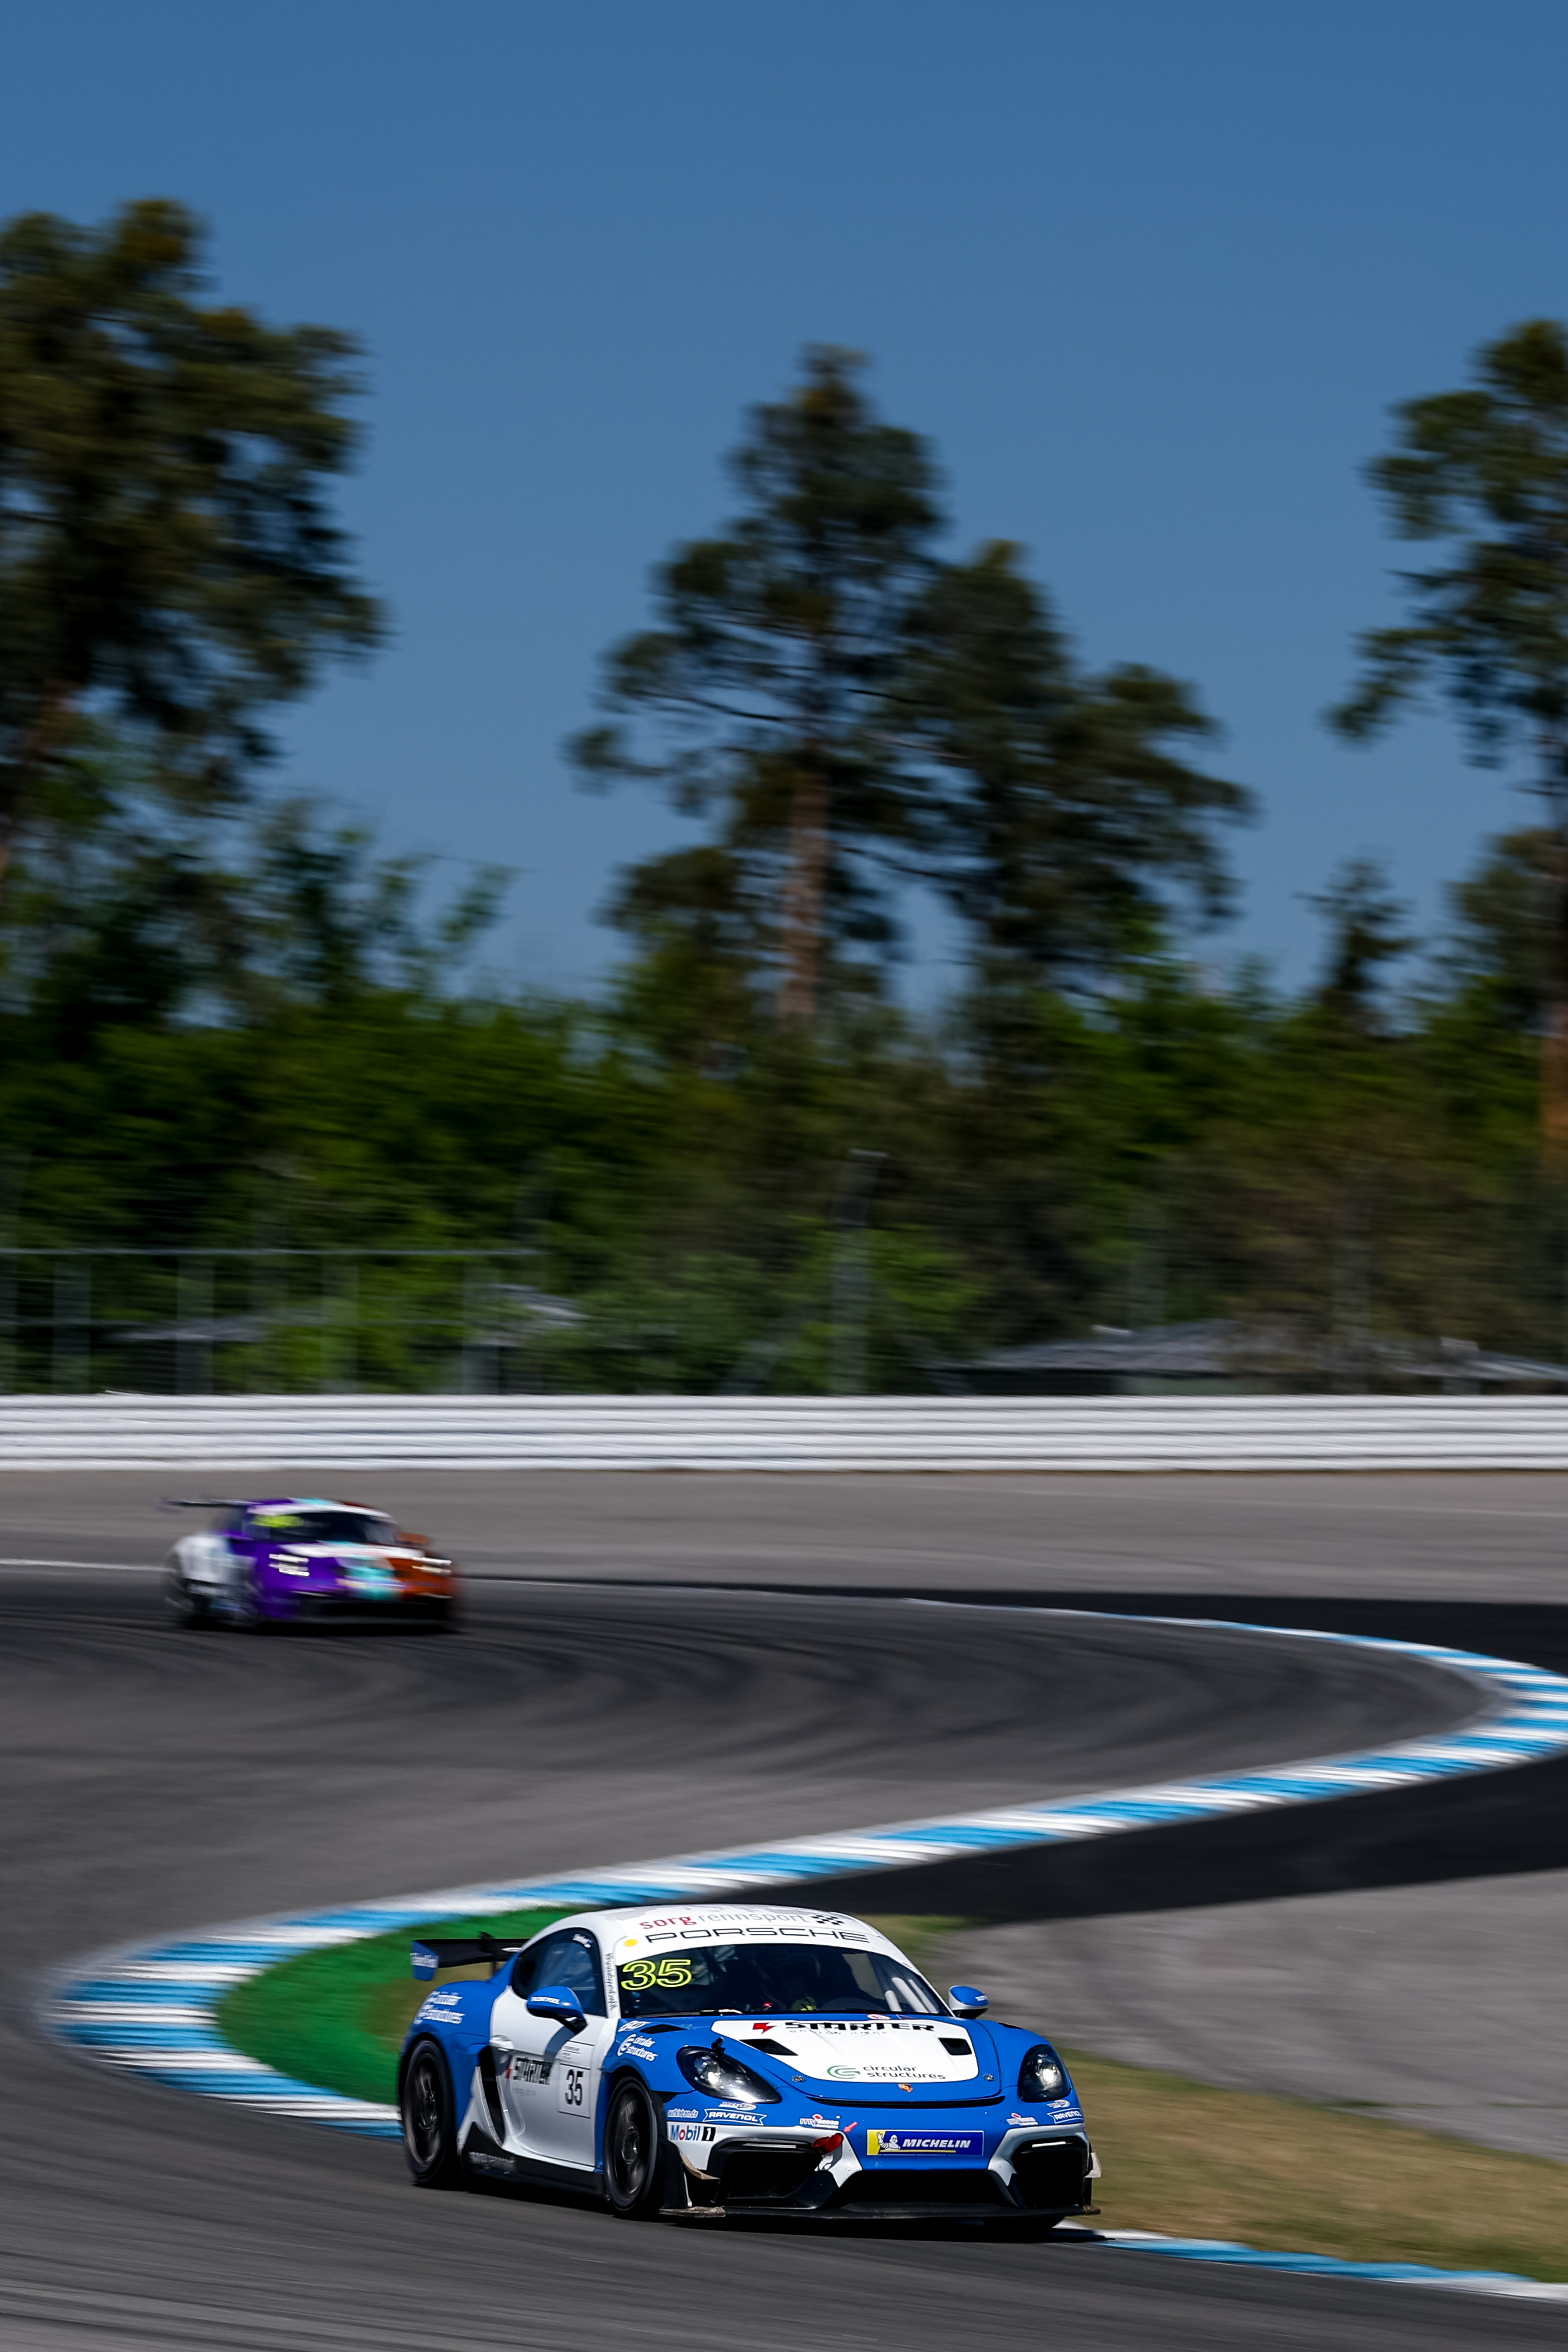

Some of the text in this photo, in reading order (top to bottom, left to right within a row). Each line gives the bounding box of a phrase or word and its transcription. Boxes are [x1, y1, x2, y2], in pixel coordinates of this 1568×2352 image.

[639, 1913, 810, 1929] sorg rennsport
[645, 1928, 870, 1943] PORSCHE
[620, 1959, 692, 1991] 35
[564, 2069, 584, 2106] 35
[708, 2111, 759, 2122] RAVENOL
[1053, 2110, 1083, 2120] RAVENOL
[670, 2124, 701, 2141] Mobil
[902, 2138, 972, 2149] MICHELIN
